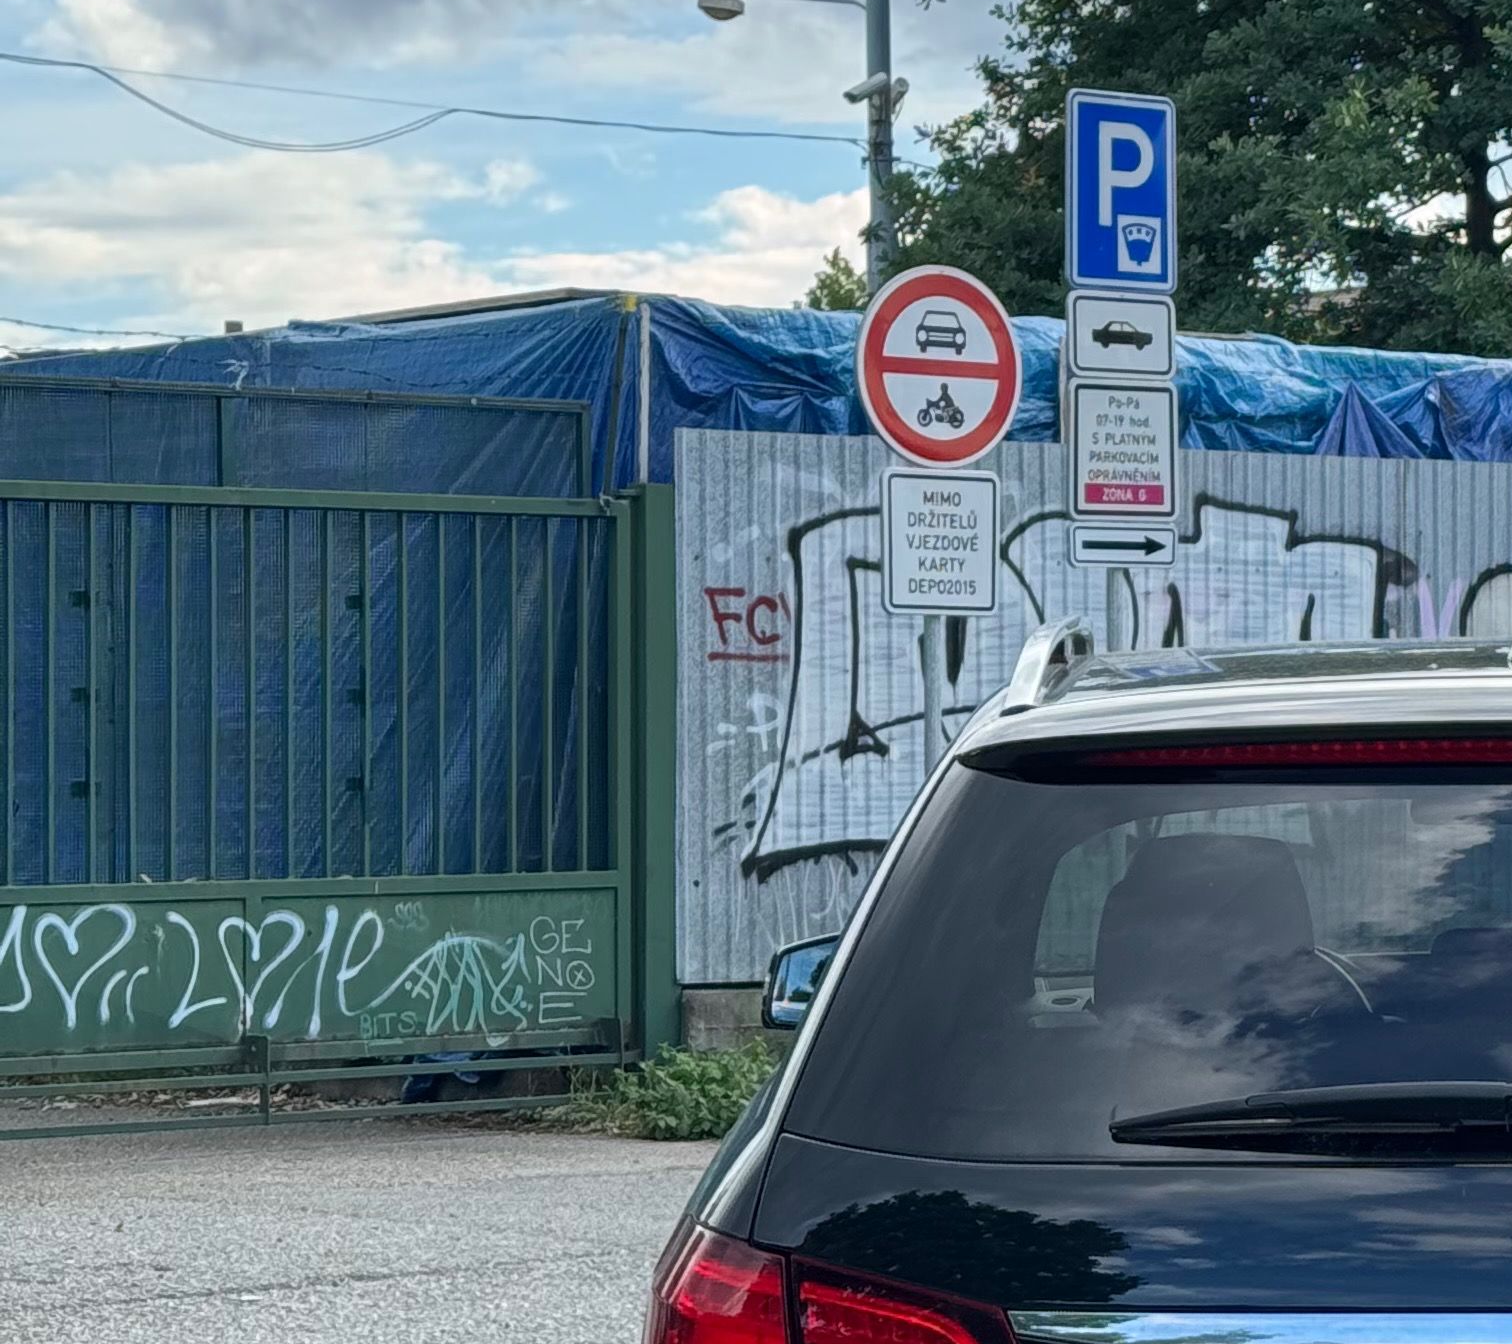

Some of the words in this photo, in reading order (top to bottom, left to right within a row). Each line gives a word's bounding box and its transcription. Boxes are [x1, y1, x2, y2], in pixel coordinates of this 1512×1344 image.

[1098, 120, 1154, 227] P
[1096, 413, 1125, 427] 07-19
[1092, 432, 1099, 445] S
[1105, 431, 1156, 446] PLATNÝM
[1089, 450, 1159, 464] PARKOVACÍM
[1087, 468, 1161, 483] OPRÁVNĚNÍM
[923, 490, 962, 507] MIMO
[1102, 485, 1133, 502] ZÓNA
[907, 509, 978, 530] DRŽITELŮ
[906, 533, 979, 552] VJEZDOVÉ
[918, 556, 966, 573] KARTY
[908, 578, 977, 596] DEPO2015
